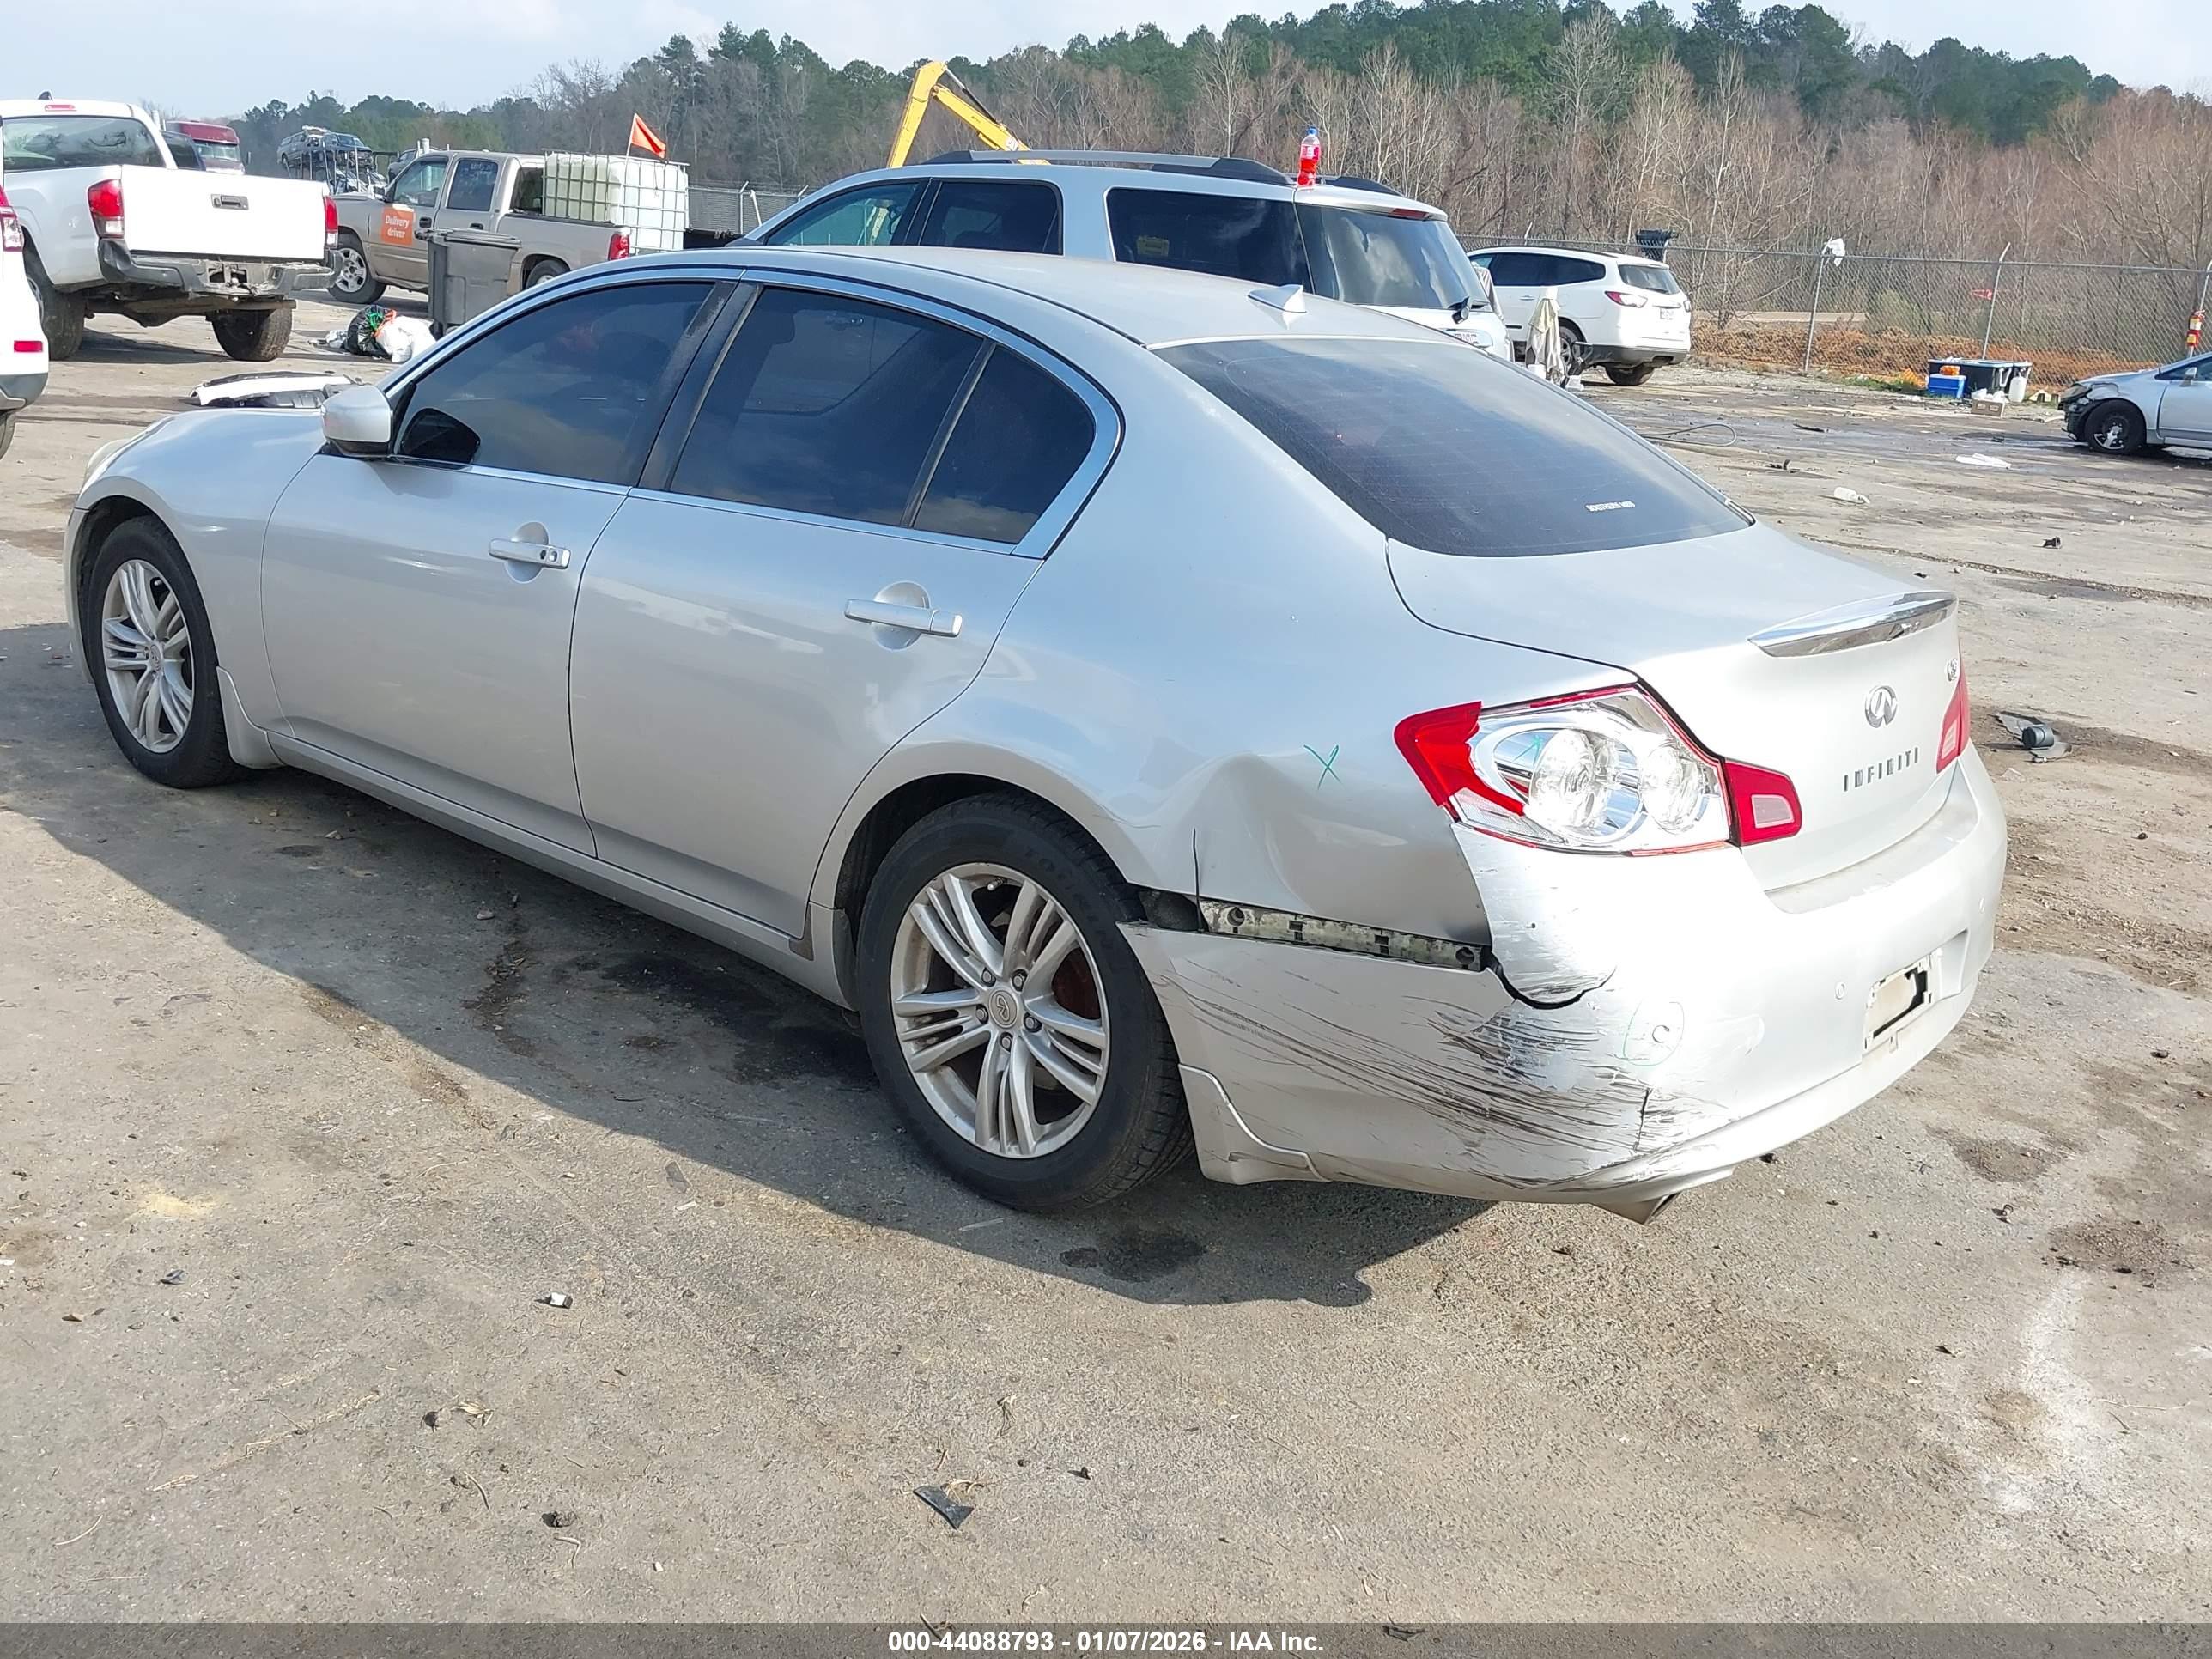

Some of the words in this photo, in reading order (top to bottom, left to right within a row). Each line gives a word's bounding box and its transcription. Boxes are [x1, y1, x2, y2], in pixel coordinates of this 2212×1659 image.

[385, 215, 410, 229] Delivery
[387, 227, 406, 238] driver
[1844, 747, 1918, 792] INFINITI
